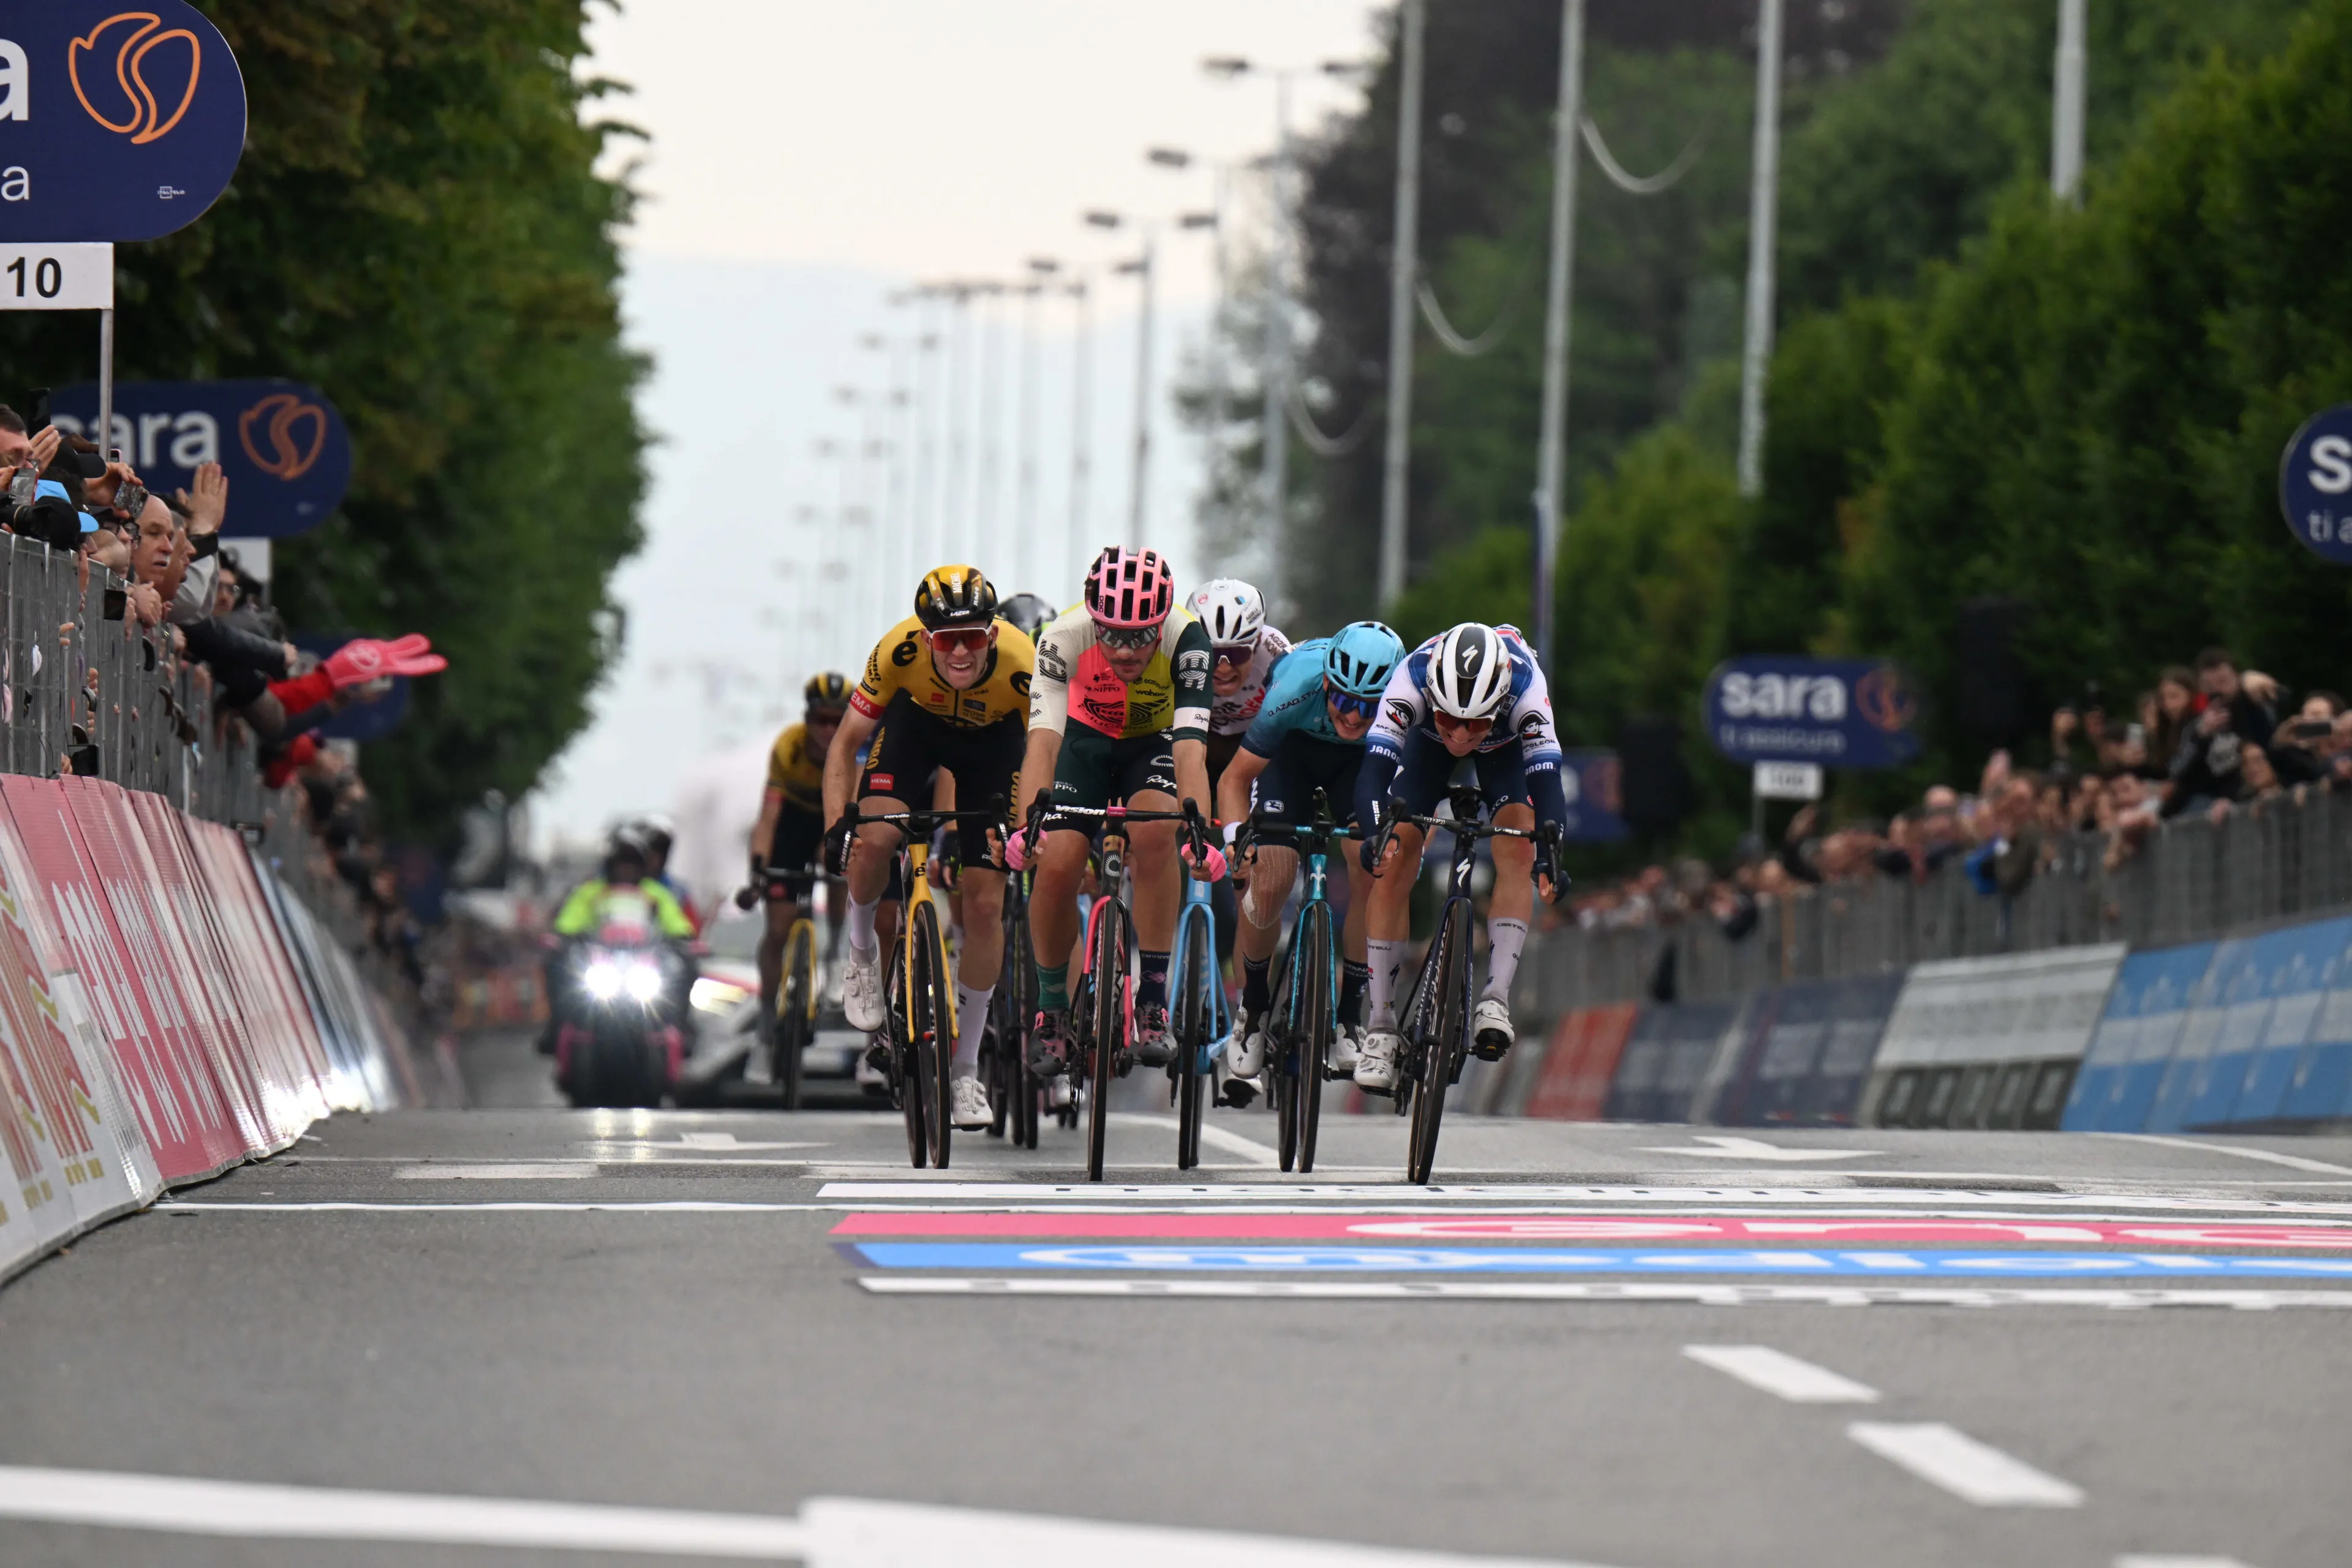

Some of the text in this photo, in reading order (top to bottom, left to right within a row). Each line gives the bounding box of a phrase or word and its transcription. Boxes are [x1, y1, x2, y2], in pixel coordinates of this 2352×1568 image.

[7, 257, 62, 298] 10
[851, 692, 871, 714] EMA
[1721, 672, 1847, 722] sara
[1146, 774, 1178, 788] Rap
[1055, 804, 1106, 815] vision
